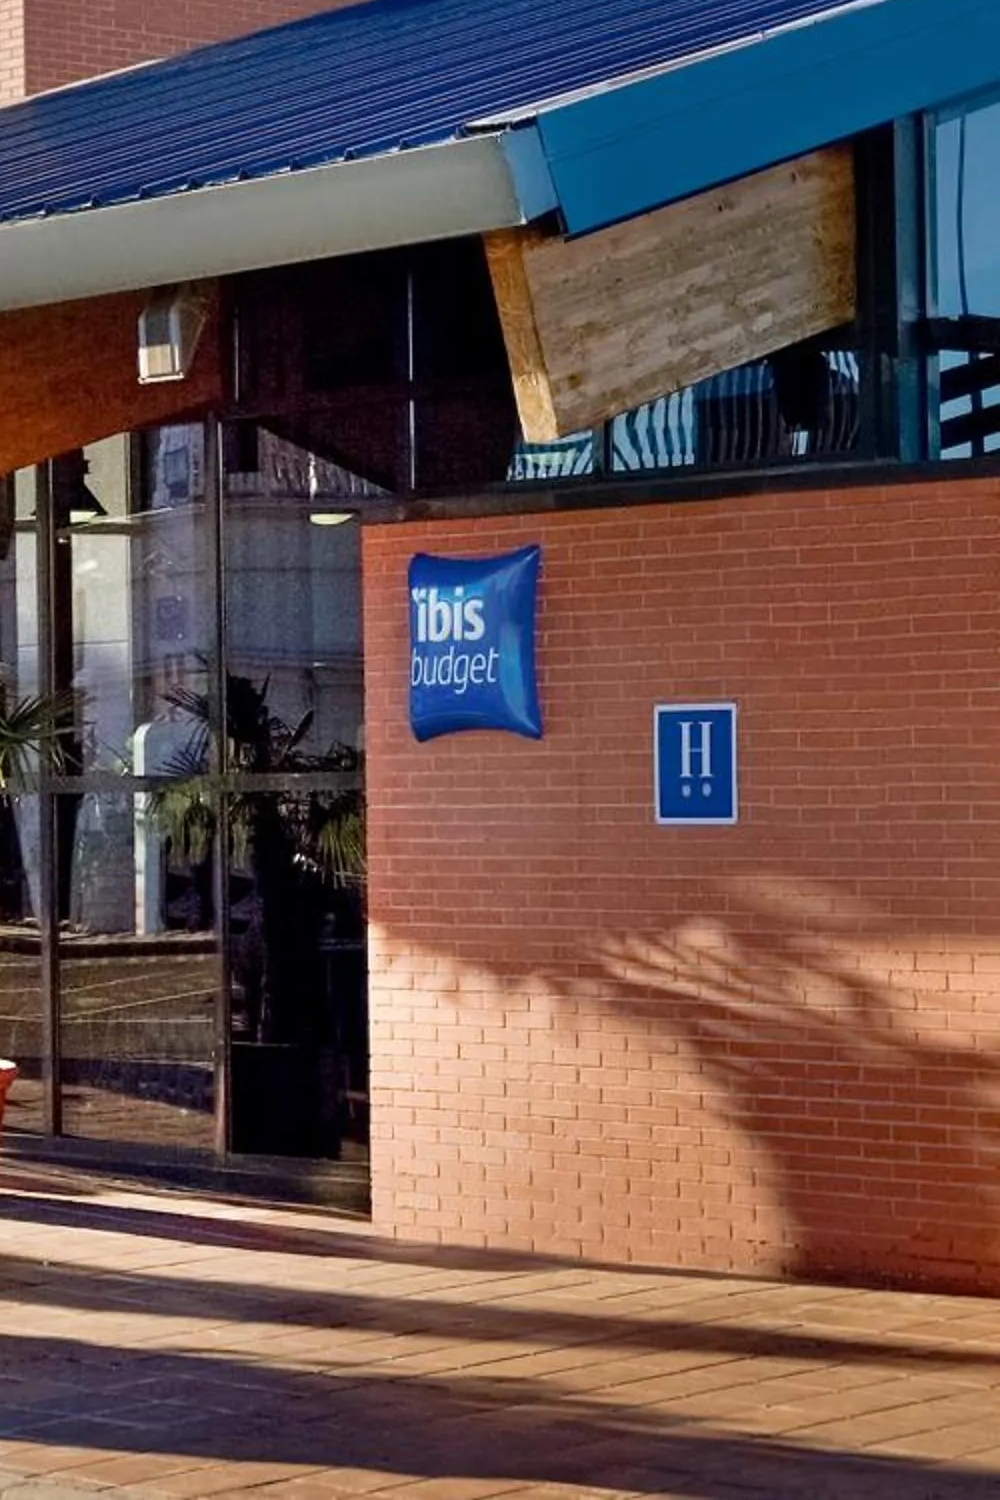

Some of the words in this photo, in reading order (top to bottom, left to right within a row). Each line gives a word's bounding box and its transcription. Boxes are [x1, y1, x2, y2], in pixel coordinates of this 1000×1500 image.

[412, 586, 486, 642] ibis
[411, 645, 499, 694] budget
[679, 721, 713, 778] H
